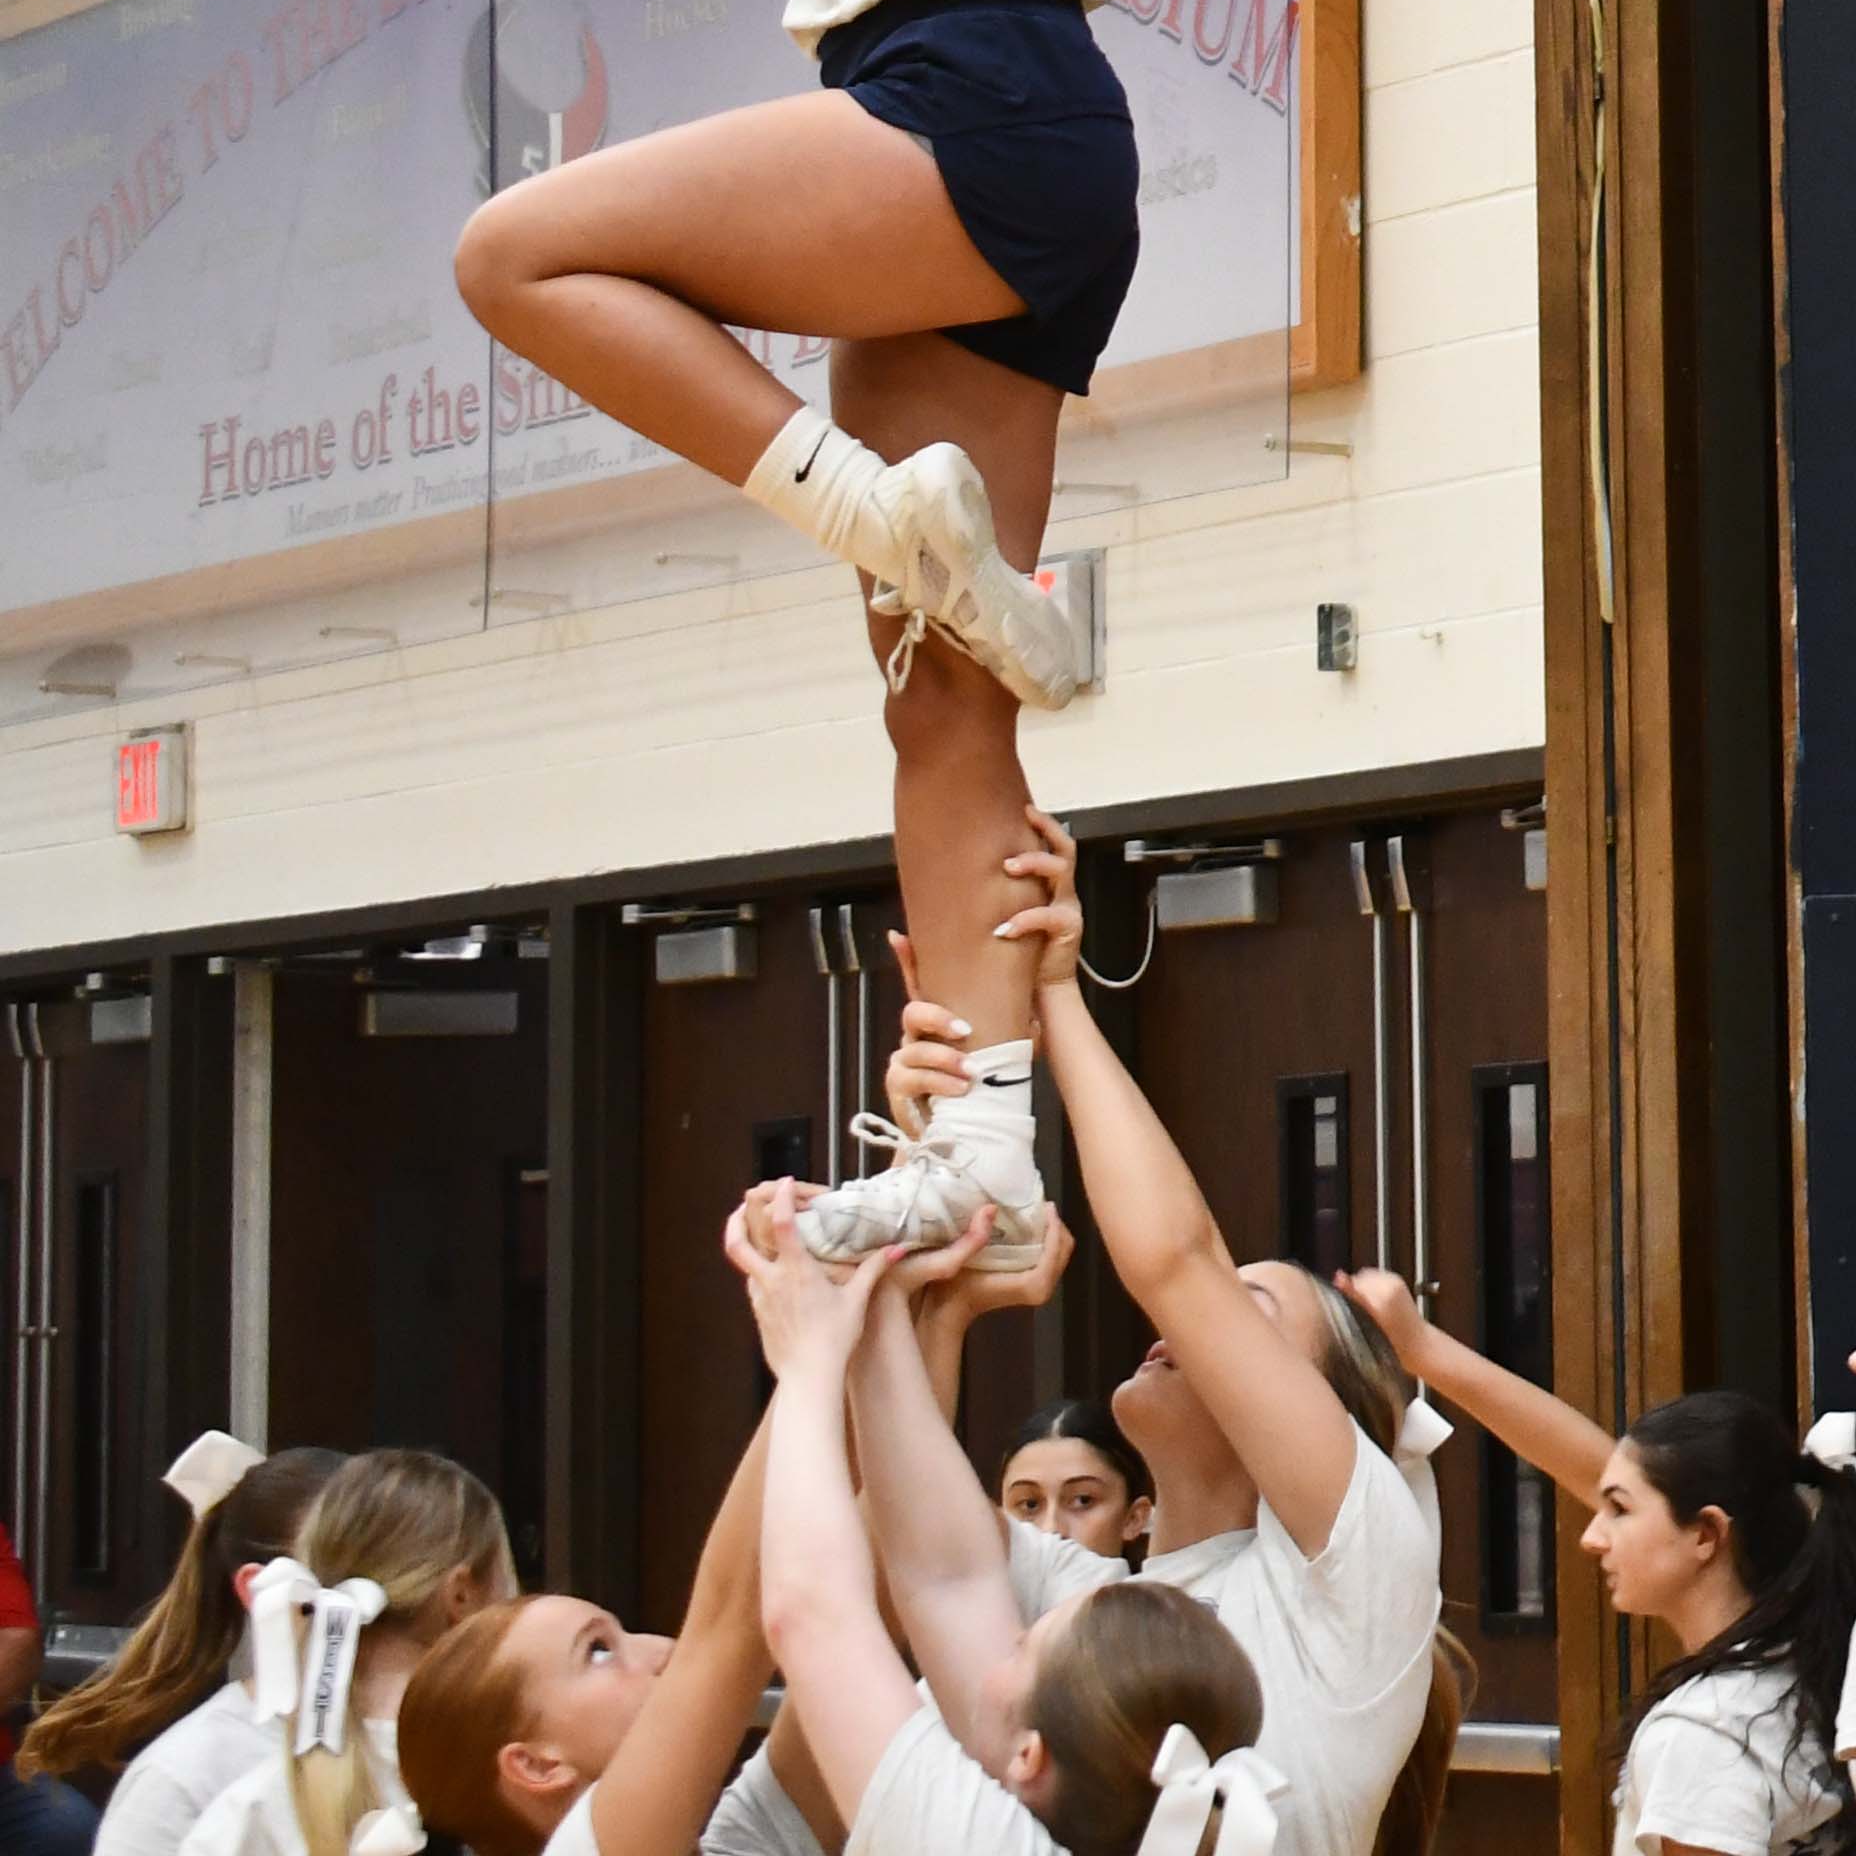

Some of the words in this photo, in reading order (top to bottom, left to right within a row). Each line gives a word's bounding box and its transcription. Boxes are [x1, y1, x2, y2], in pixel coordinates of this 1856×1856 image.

[0, 120, 185, 416] ELCOME
[197, 413, 338, 508] Home
[352, 371, 398, 471] of
[407, 364, 481, 457] the
